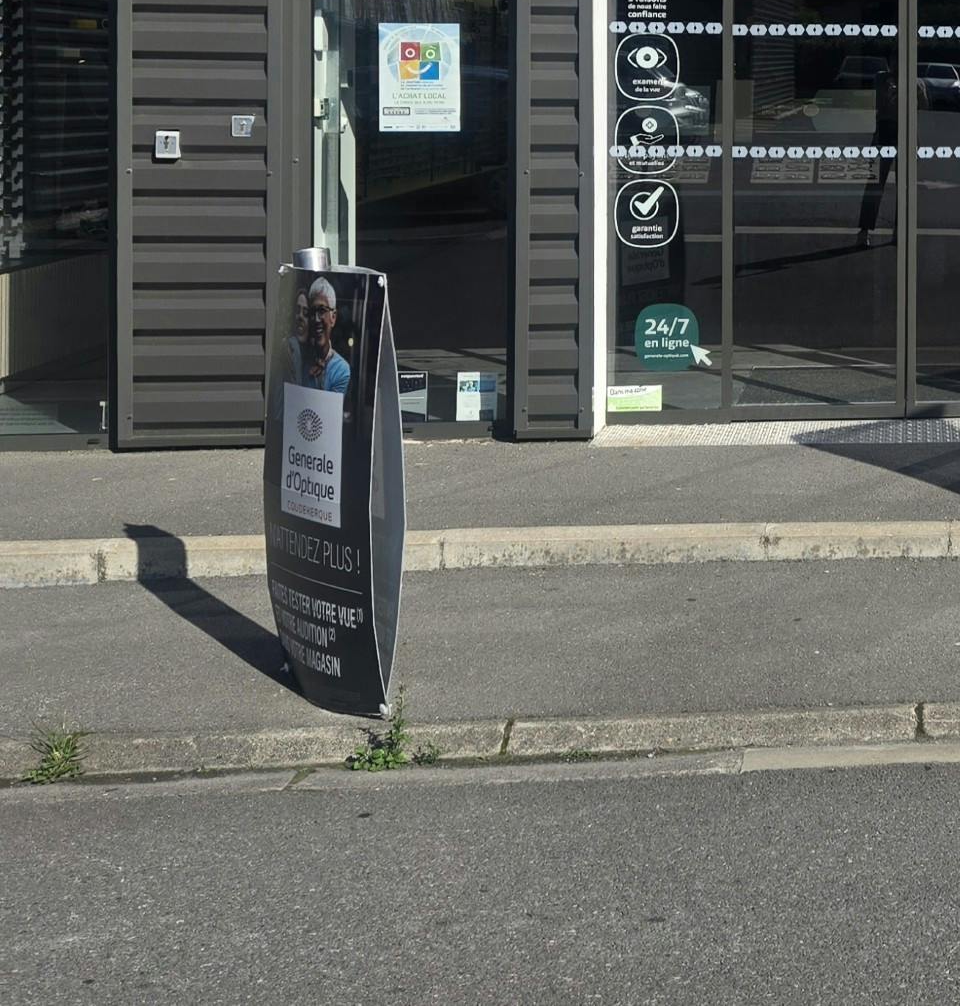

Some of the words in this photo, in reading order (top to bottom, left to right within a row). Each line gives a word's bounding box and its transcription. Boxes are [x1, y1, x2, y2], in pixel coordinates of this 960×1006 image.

[627, 10, 667, 19] confiance
[631, 224, 663, 234] garantie
[644, 317, 690, 337] 24/7
[644, 339, 659, 349] en
[661, 337, 690, 351] ligne
[288, 445, 334, 475] Generale
[286, 469, 335, 502] d'Optique
[287, 499, 333, 522] COUDEKERQUE
[323, 540, 353, 573] PLUS
[288, 588, 311, 616] TESTER
[311, 597, 337, 624] VOTRE
[305, 647, 342, 678] MAGASIN
